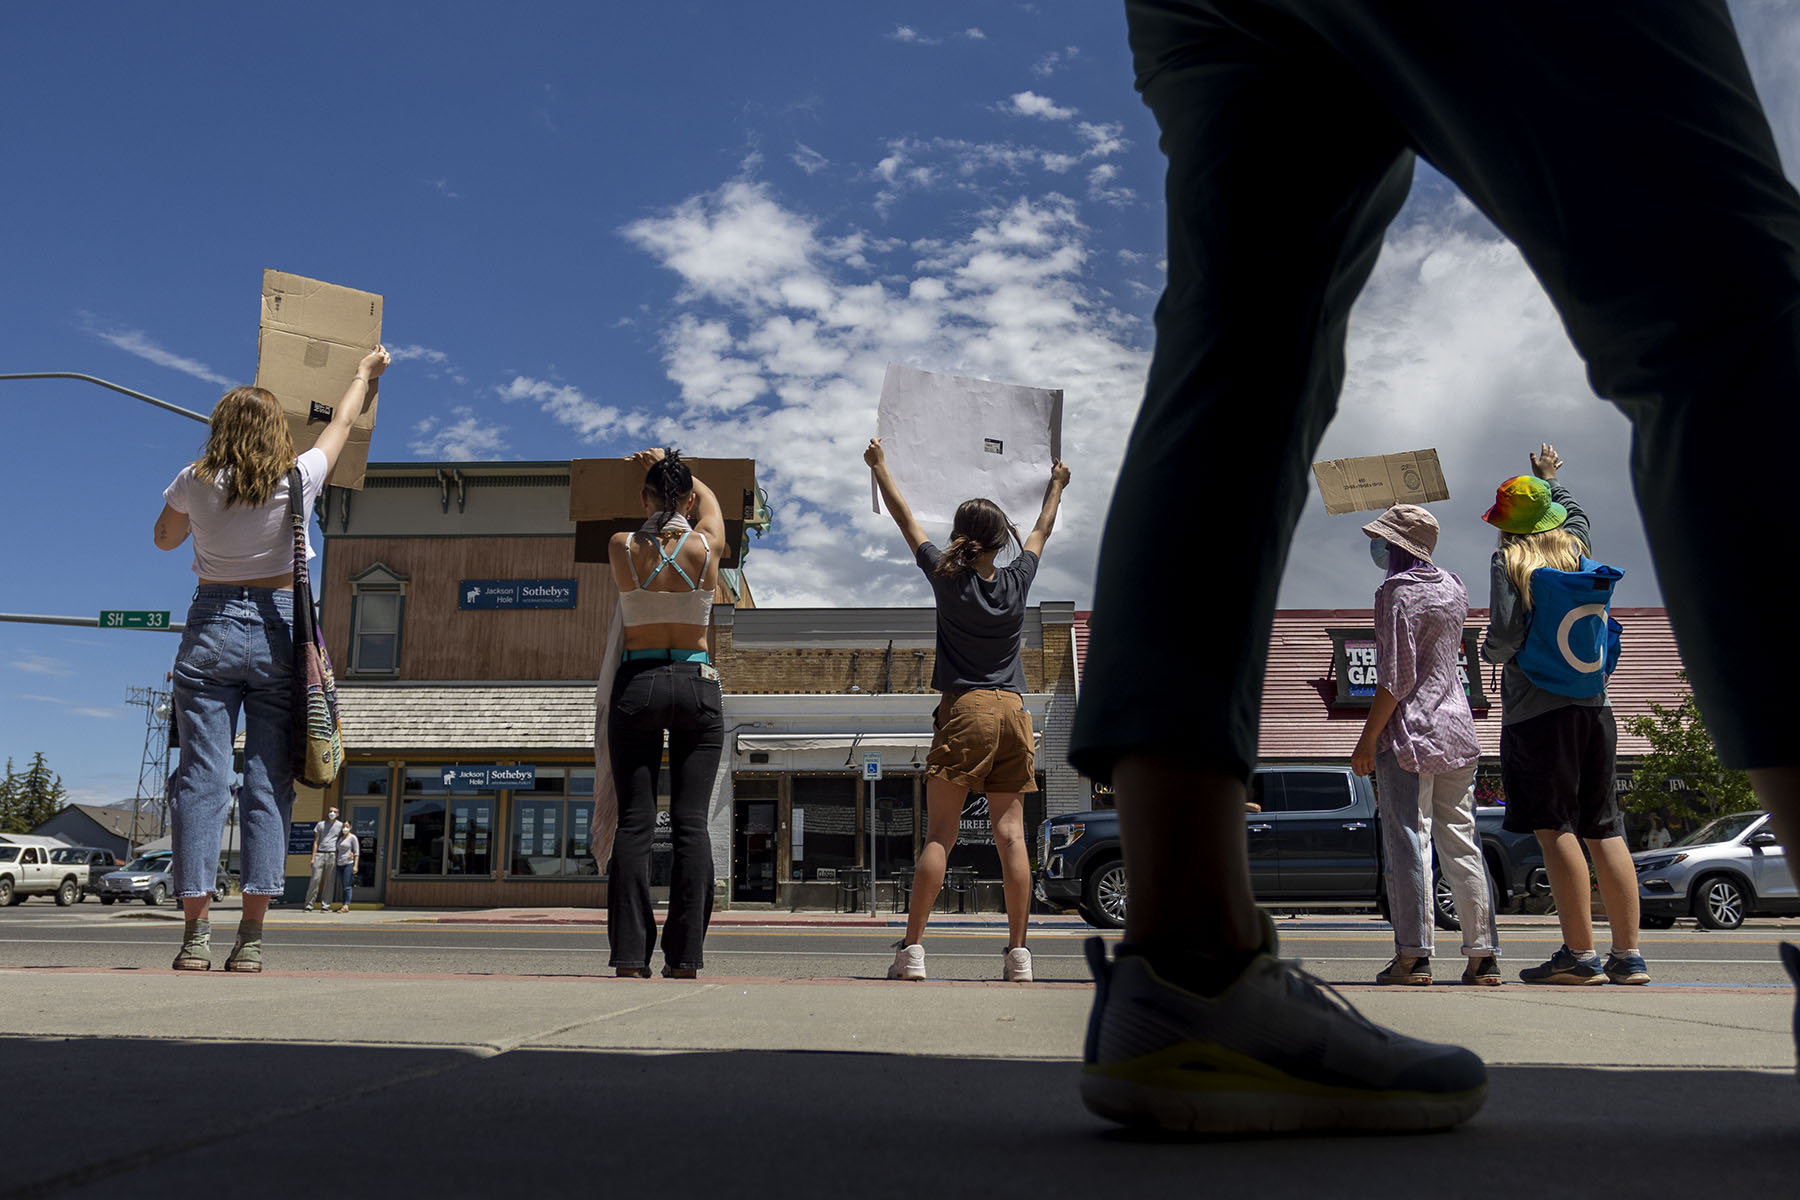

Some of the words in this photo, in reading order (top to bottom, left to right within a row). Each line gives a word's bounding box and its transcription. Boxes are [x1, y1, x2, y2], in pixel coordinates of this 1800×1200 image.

[485, 587, 514, 595] Jackson
[522, 586, 570, 598] Sotheby's
[496, 596, 513, 604] Hole
[107, 613, 124, 626] SH
[146, 613, 163, 626] 33
[491, 769, 533, 780] Sotheby's
